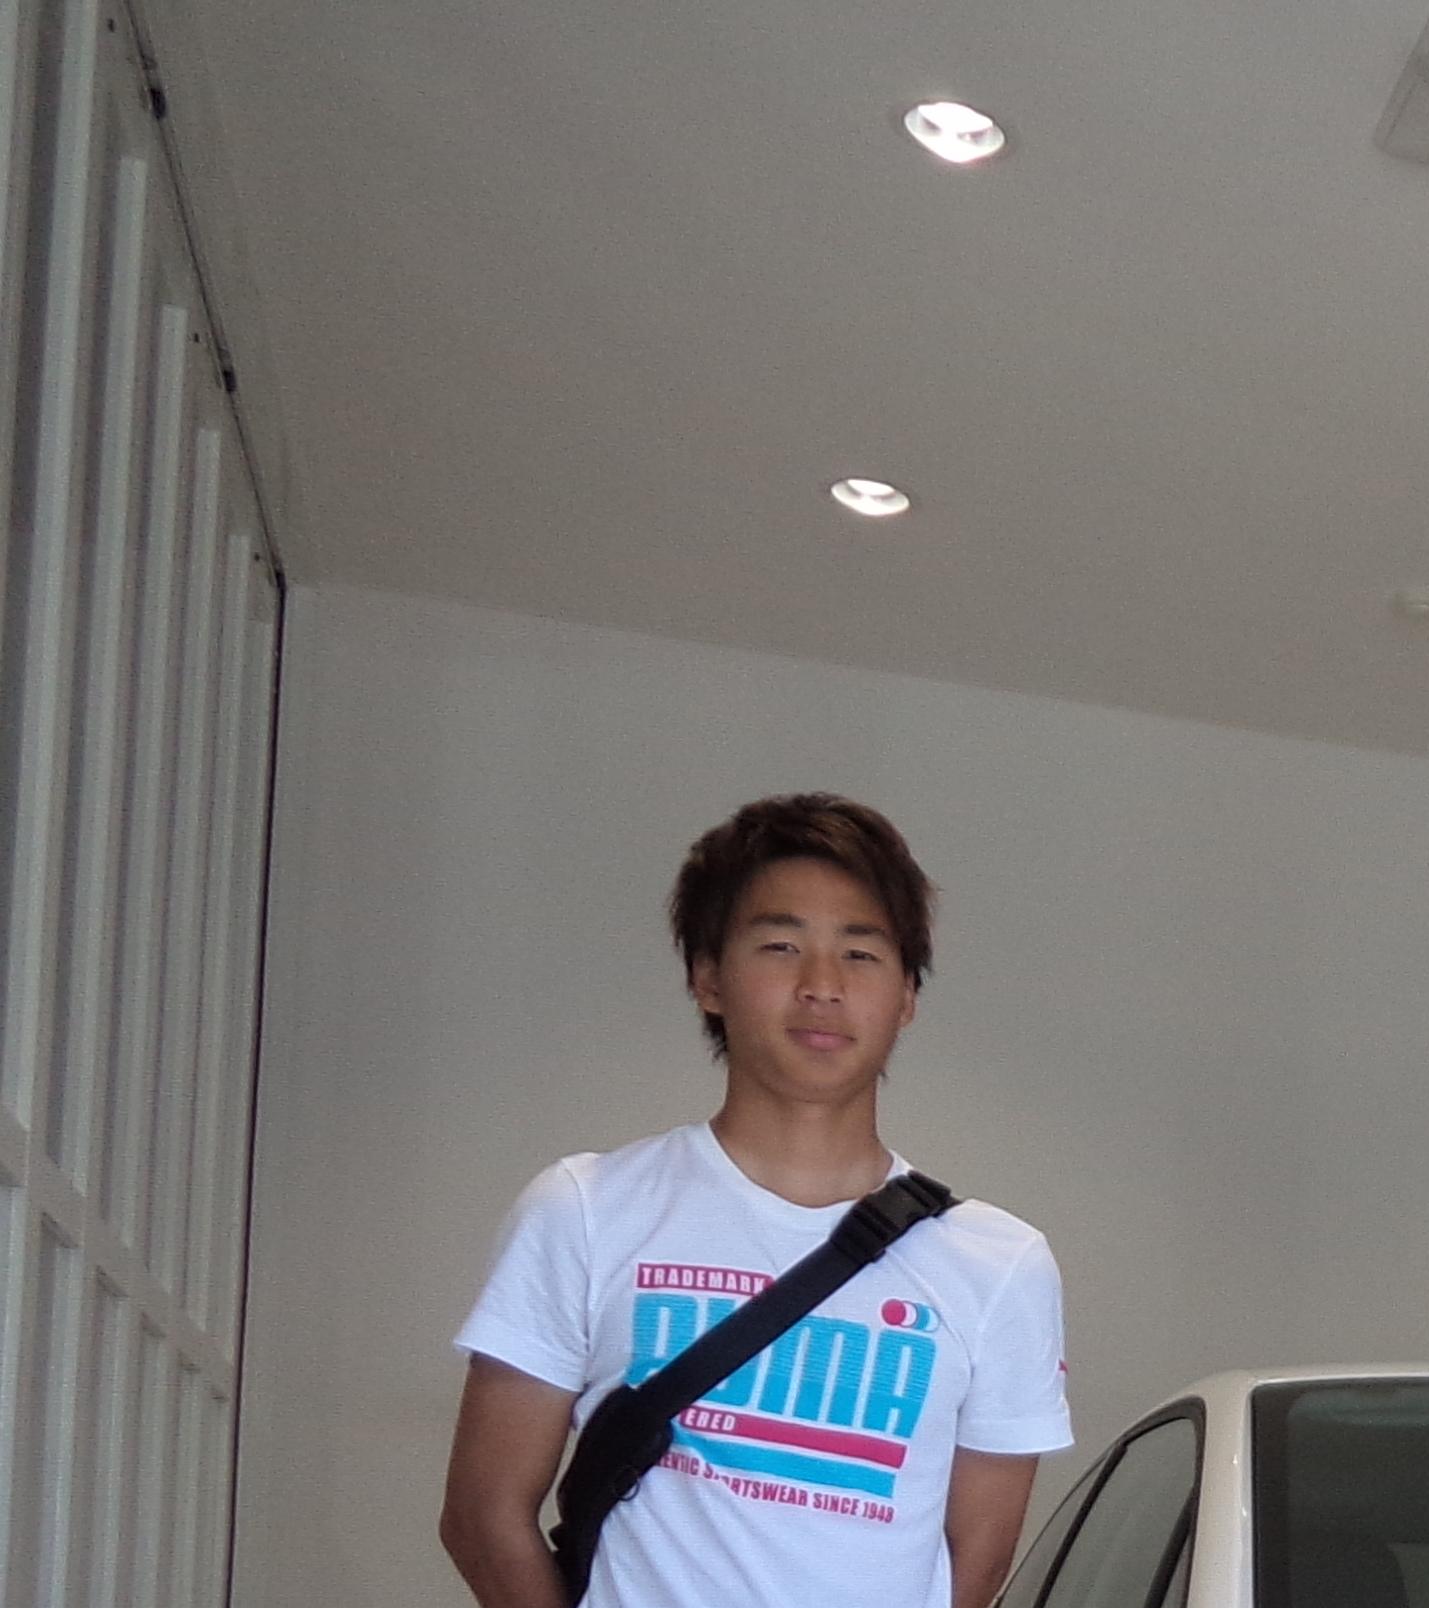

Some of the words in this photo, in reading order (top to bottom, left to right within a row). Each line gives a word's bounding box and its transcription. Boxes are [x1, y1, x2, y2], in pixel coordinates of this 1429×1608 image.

[642, 1266, 766, 1294] TRADEMARK
[703, 1461, 808, 1507] SRTSWEAR
[813, 1492, 861, 1517] SINCE
